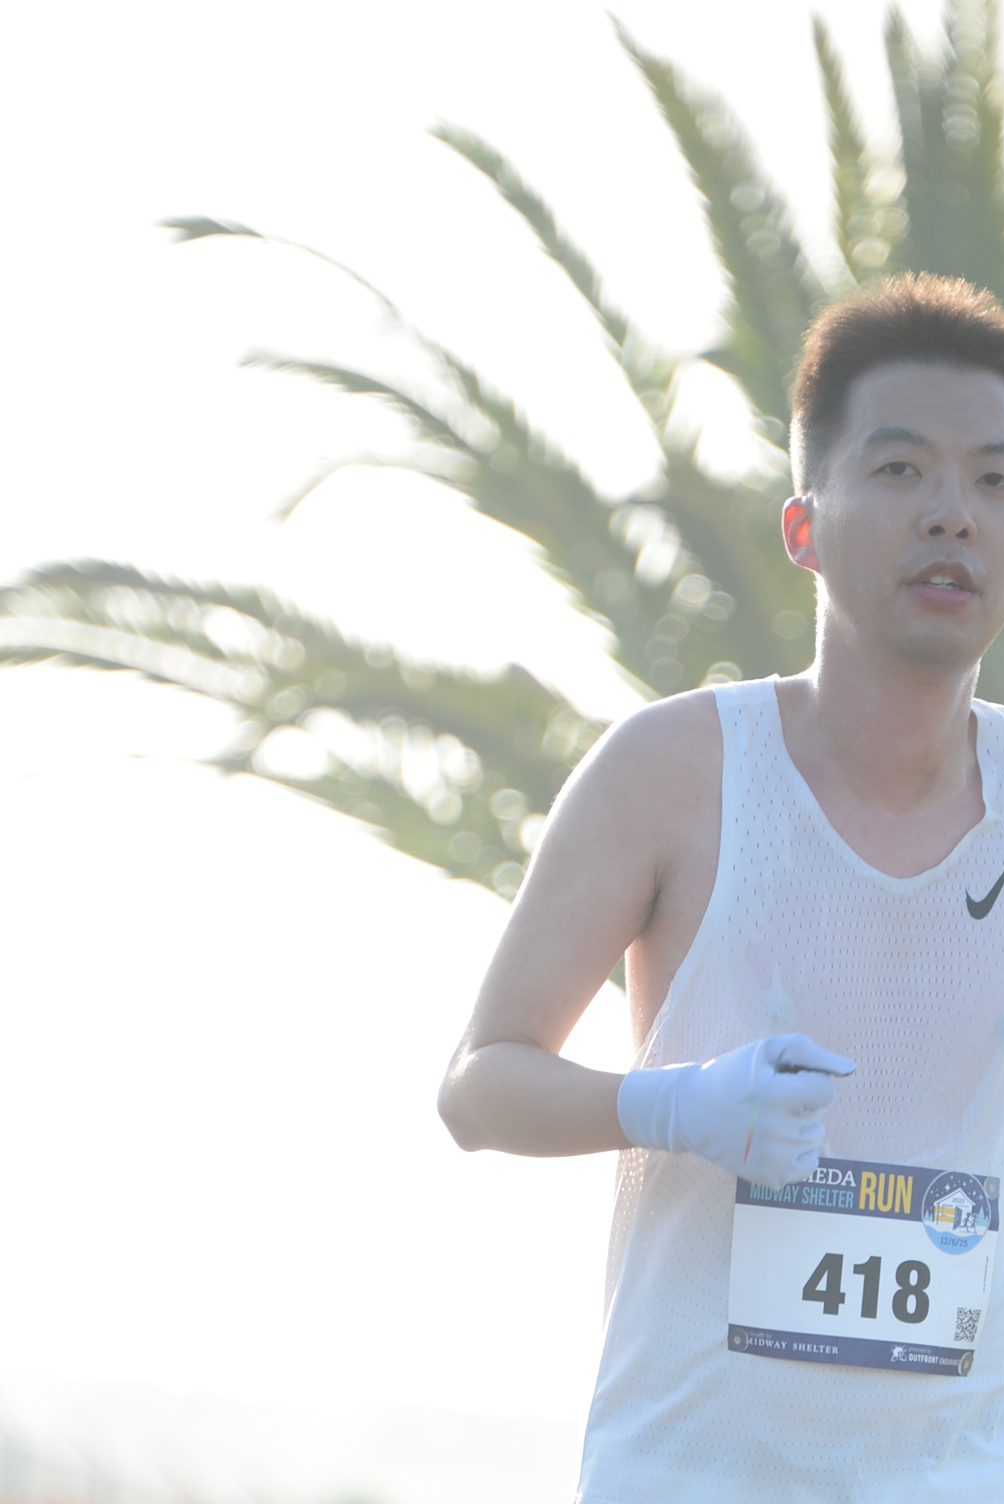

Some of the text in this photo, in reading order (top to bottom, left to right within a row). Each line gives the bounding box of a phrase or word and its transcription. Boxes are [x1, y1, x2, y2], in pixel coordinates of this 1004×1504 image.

[803, 1167, 857, 1187] EDA
[749, 1183, 854, 1209] MIDWAY SHELTER
[858, 1171, 913, 1214] RUN
[940, 1236, 968, 1248] 12/6/25
[801, 1252, 931, 1324] 418
[747, 1337, 839, 1354] MIDWAY SHELTER
[908, 1353, 939, 1364] OUTFRONT
